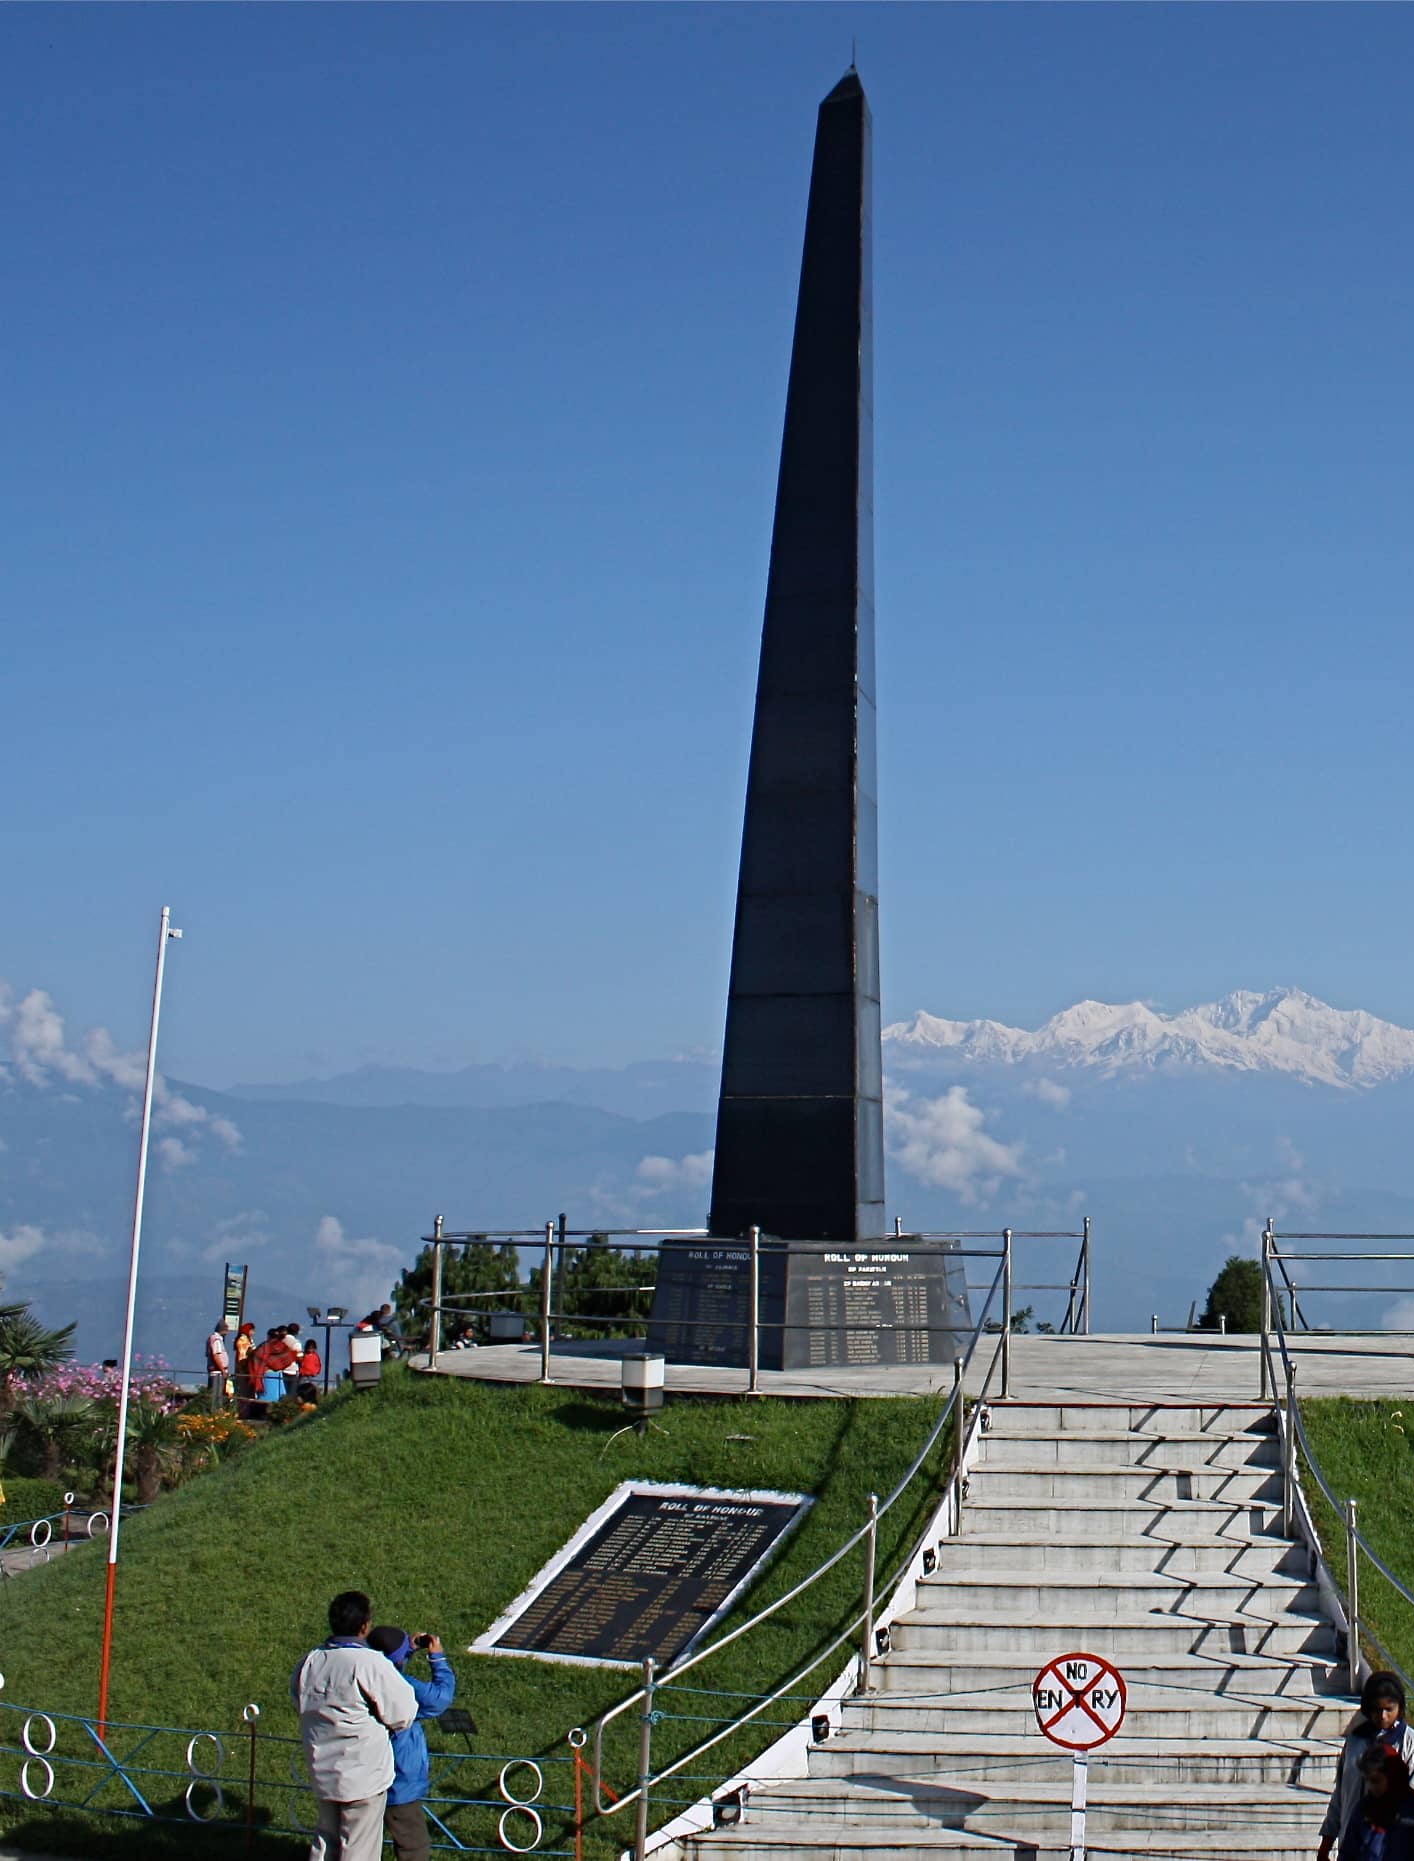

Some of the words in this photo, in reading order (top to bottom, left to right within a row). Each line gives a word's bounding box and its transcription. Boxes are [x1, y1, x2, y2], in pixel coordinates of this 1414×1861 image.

[659, 1501, 688, 1512] ROLL
[694, 1504, 712, 1514] OF
[712, 1505, 764, 1517] HONOUR
[1066, 1662, 1087, 1680] NO
[1037, 1689, 1120, 1709] ENTRY
